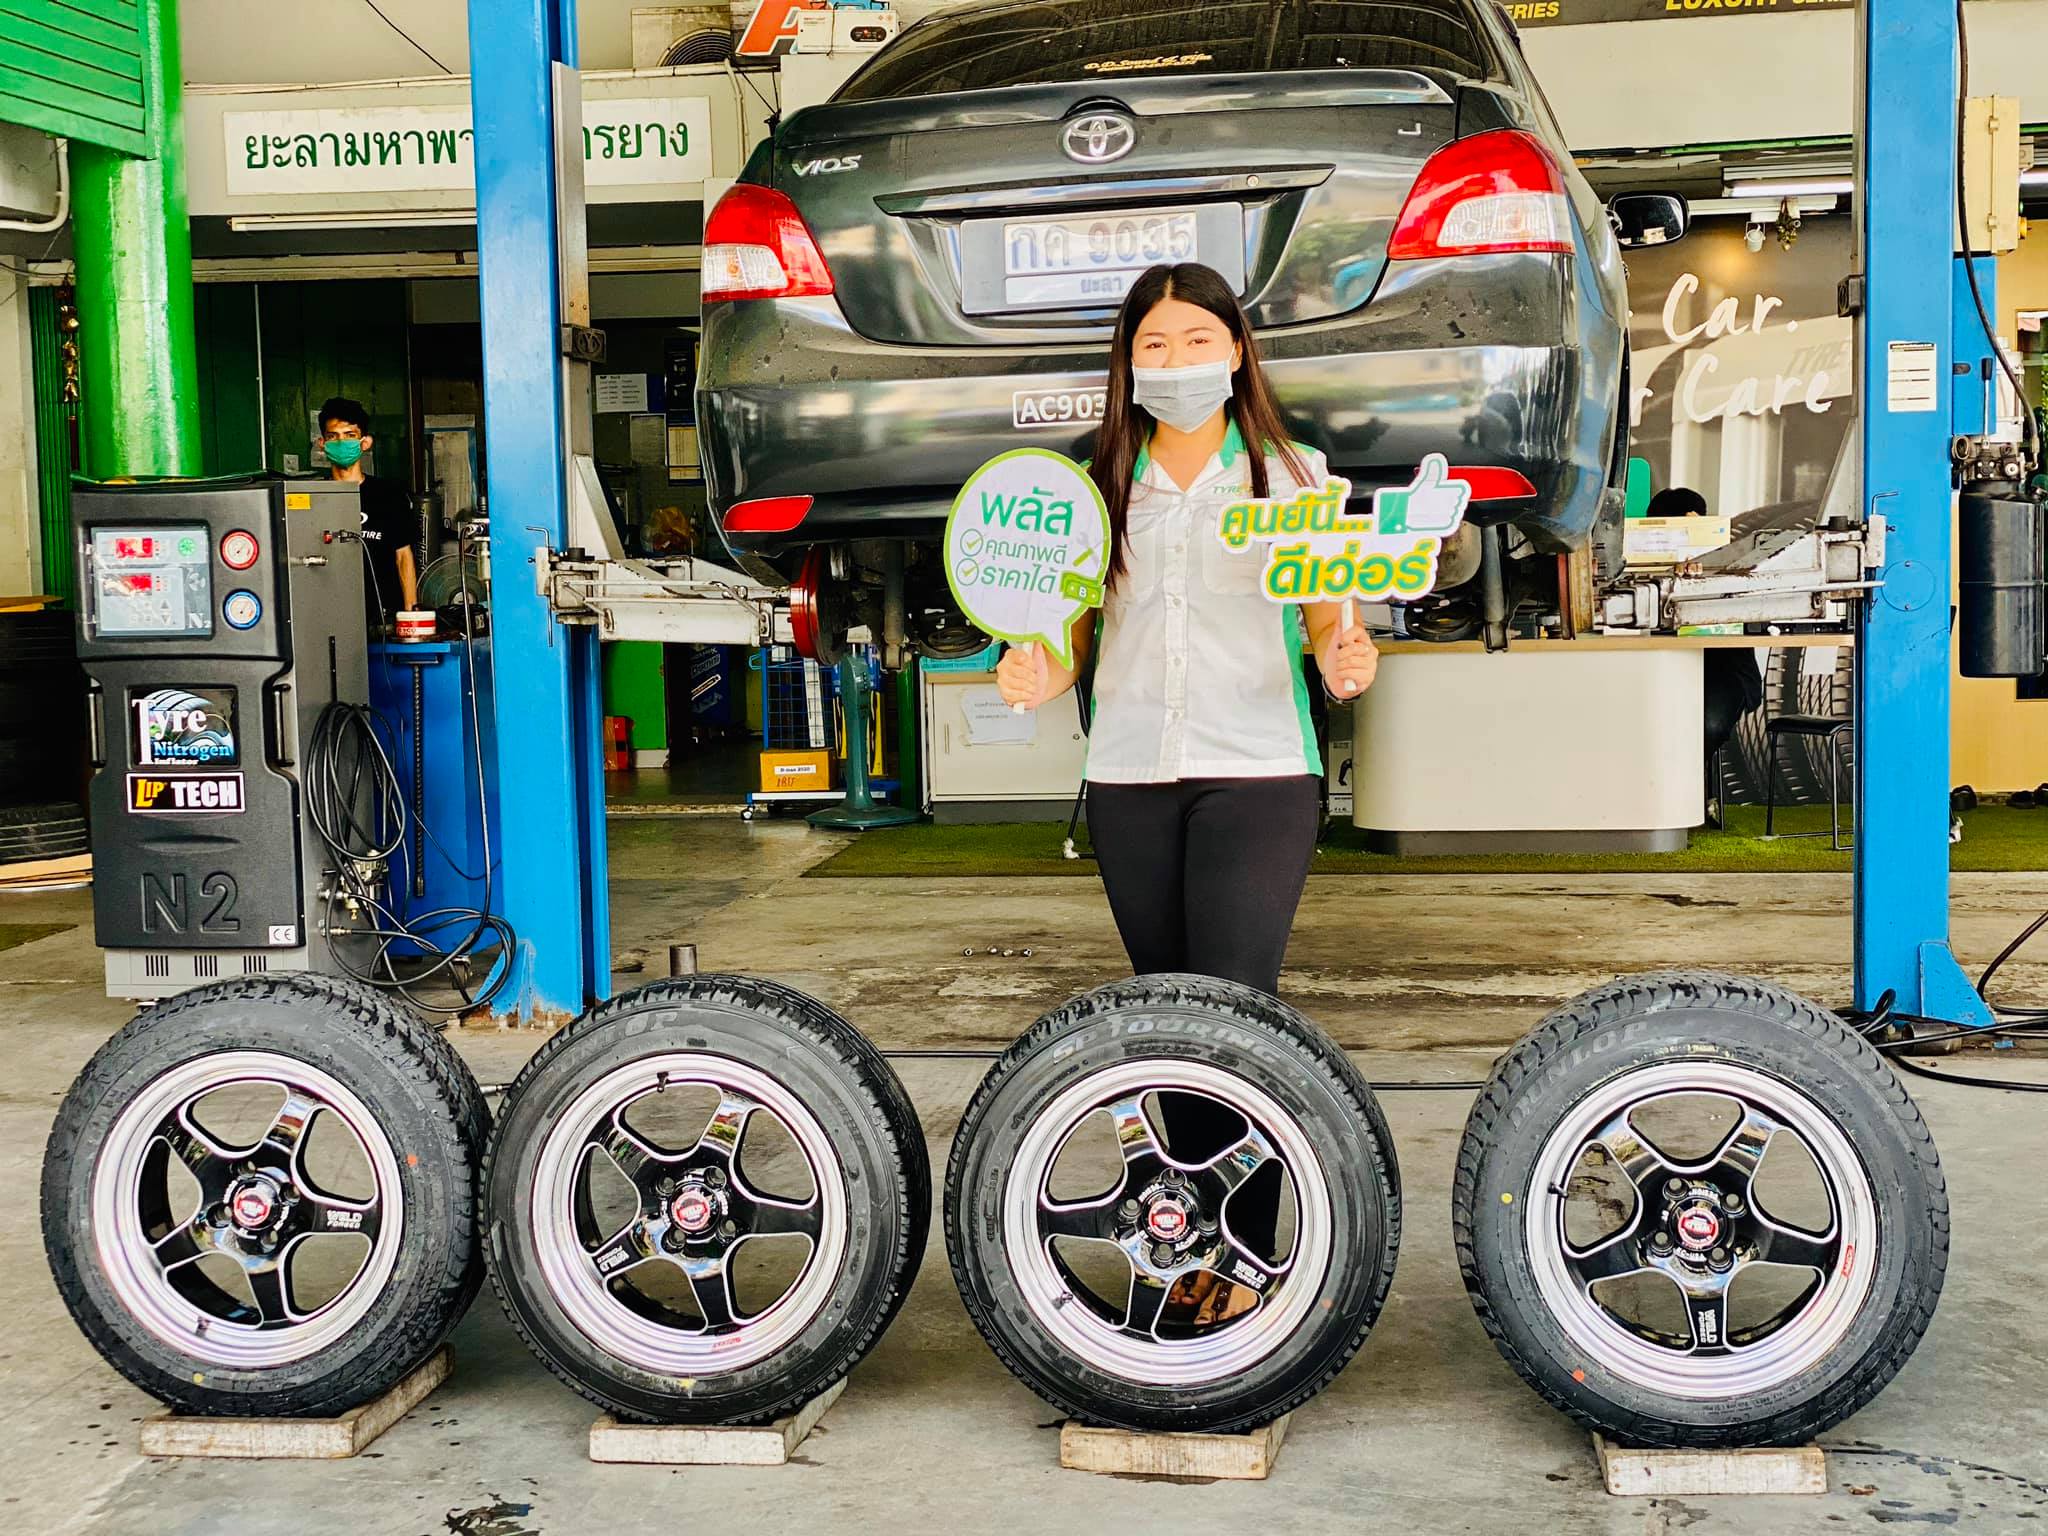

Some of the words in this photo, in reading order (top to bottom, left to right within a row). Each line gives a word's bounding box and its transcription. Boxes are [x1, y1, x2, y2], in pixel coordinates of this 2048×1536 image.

[791, 154, 862, 177] VIOS
[1088, 216, 1194, 264] 9035
[1662, 272, 1799, 344] Car.
[1682, 353, 1833, 424] Care
[980, 486, 1075, 537] พลัส
[361, 530, 382, 540] TIRE
[985, 537, 1068, 566] คุณภาพดี
[980, 563, 1059, 595] ราคาได้
[1270, 542, 1431, 595] ดีเว่อร์
[131, 698, 208, 766] Tyre
[153, 741, 232, 761] Nitrogen
[170, 780, 238, 807] TECH
[141, 871, 241, 934] N2
[1106, 1013, 1281, 1064] TOURING
[1509, 1020, 1648, 1133] DUNLOP
[327, 1210, 362, 1222] WELD
[1235, 1259, 1268, 1285] WELD
[1704, 1308, 1718, 1344] WELD
